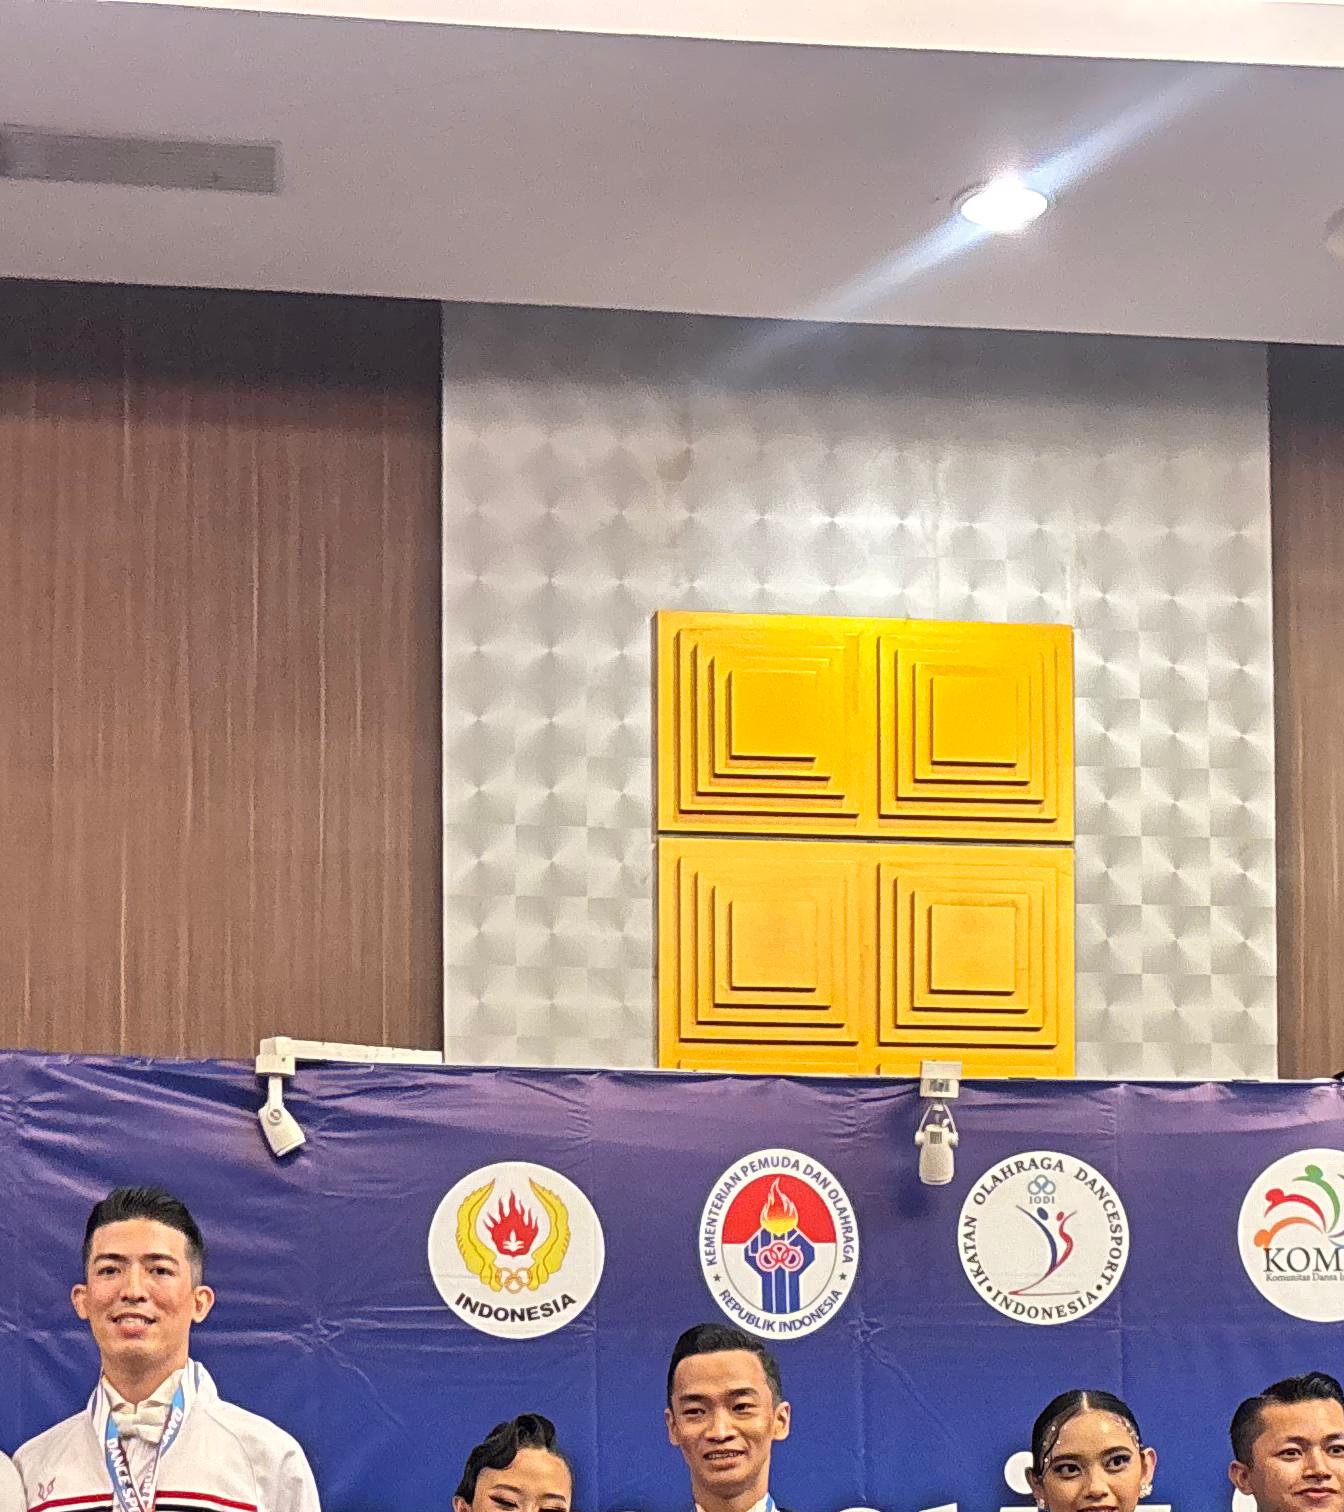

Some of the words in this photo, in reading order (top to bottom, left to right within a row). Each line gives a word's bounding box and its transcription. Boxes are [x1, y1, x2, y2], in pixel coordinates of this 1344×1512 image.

[973, 1157, 1065, 1206] OLAHRAGA
[1029, 1196, 1055, 1205] IODI
[704, 1172, 742, 1266] KEMENTERIAN
[741, 1156, 800, 1177] PEMUDA
[803, 1164, 831, 1190] DAN
[827, 1189, 855, 1264] OLAHRAGA
[1073, 1167, 1123, 1286] DANCESPORT
[963, 1215, 990, 1287] IKATAN
[455, 1292, 576, 1323] INDONESIA
[719, 1289, 776, 1332] REPUBLIK
[778, 1289, 843, 1333] INDONESIA
[990, 1290, 1098, 1321] INDONESIA
[106, 1437, 129, 1487] DANCE
